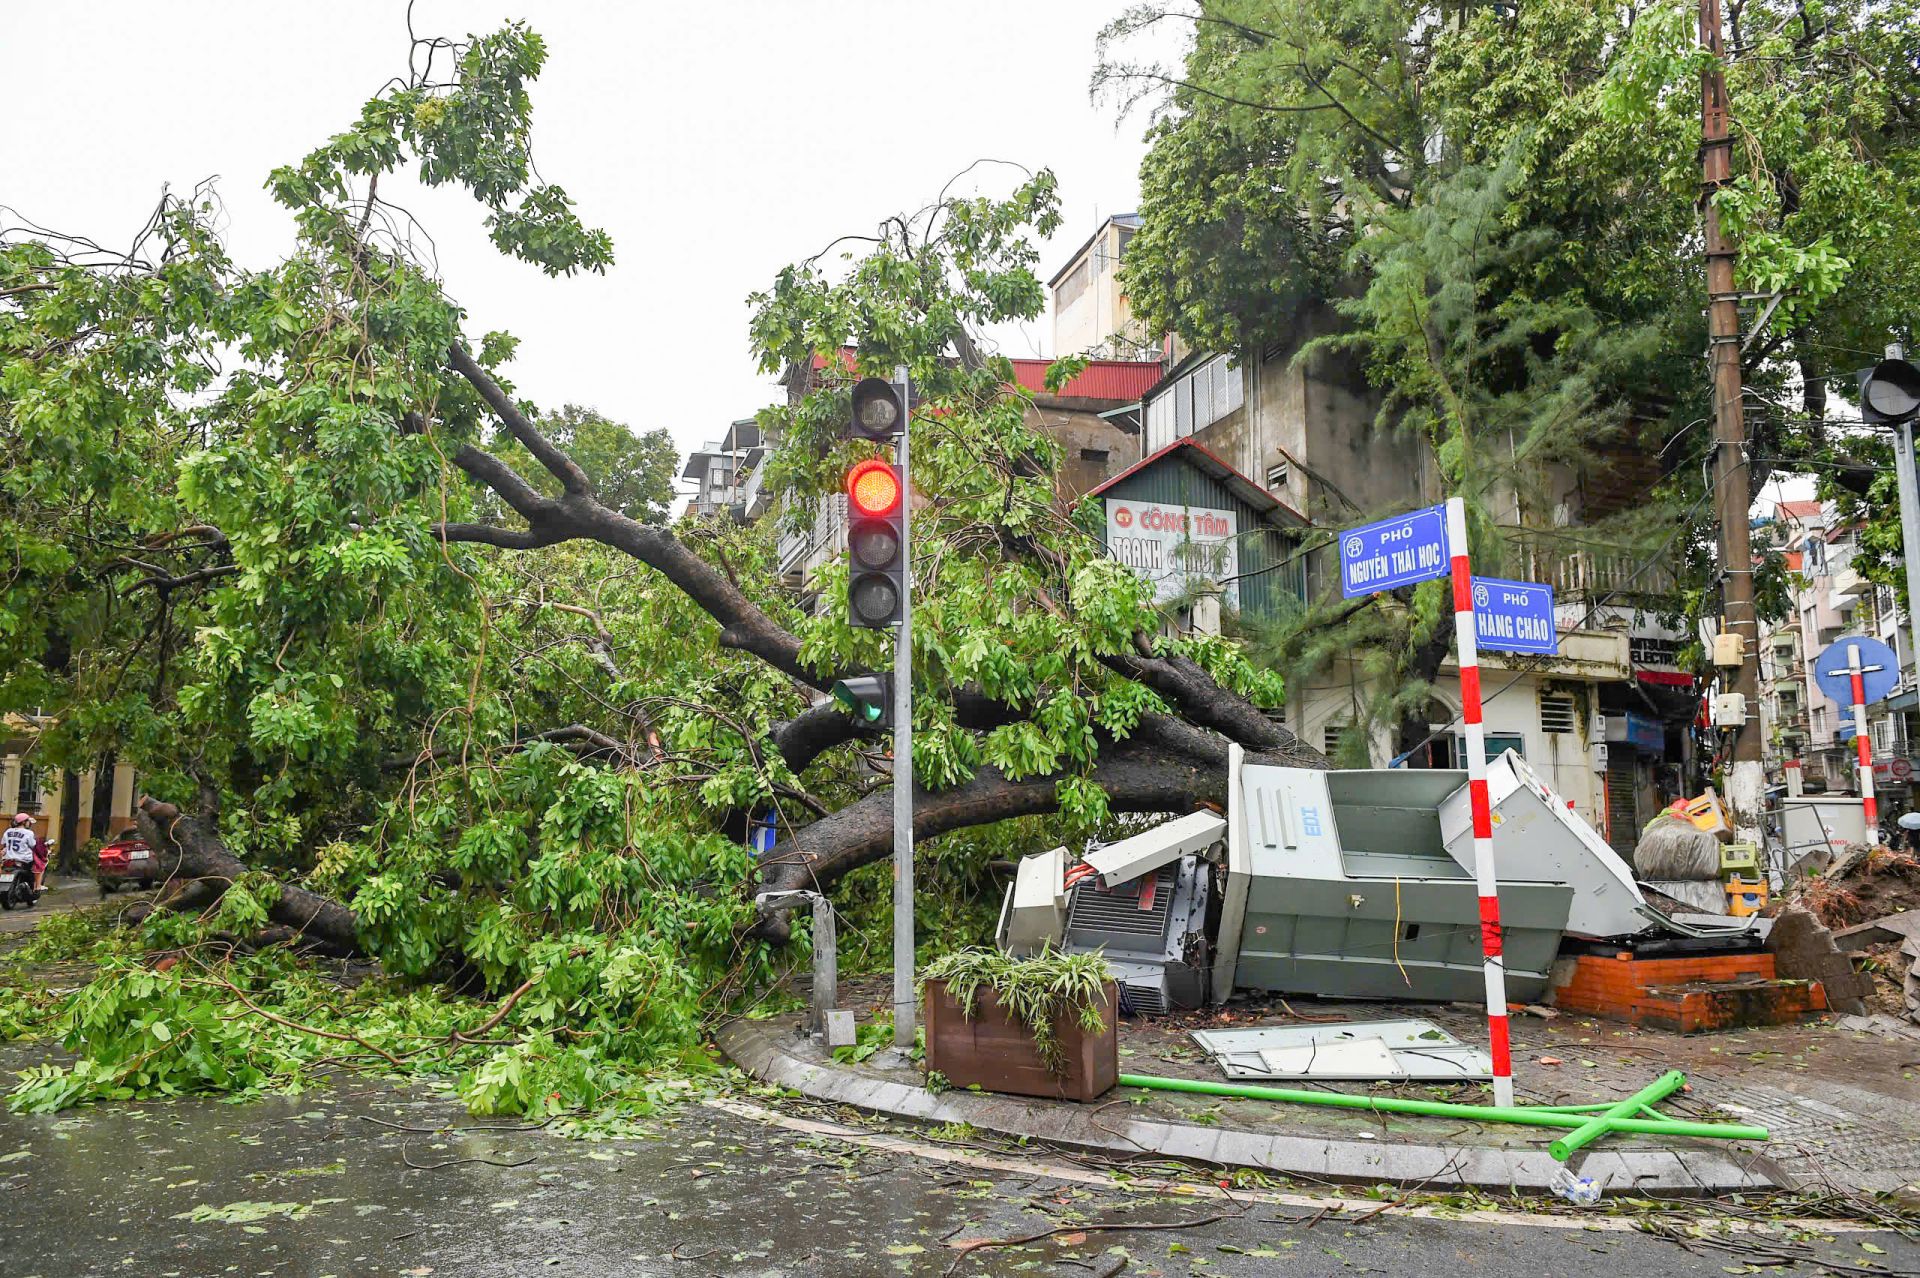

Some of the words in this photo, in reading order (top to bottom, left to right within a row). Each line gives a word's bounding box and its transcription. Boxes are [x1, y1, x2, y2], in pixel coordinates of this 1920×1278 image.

[1140, 506, 1191, 533] CÔNG
[1194, 511, 1229, 537] TÂM
[1380, 520, 1414, 545] PHỐ
[1113, 537, 1162, 569] TRANH
[1349, 549, 1388, 585] NGUYỄN
[1392, 544, 1416, 575] THÁI
[1418, 542, 1441, 572] HỌC
[1503, 590, 1530, 607] PHỐ
[1477, 609, 1514, 639] HÀNG
[1516, 611, 1549, 642] CHÁO
[1630, 651, 1680, 665] ELECTR
[8, 839, 21, 852] 15
